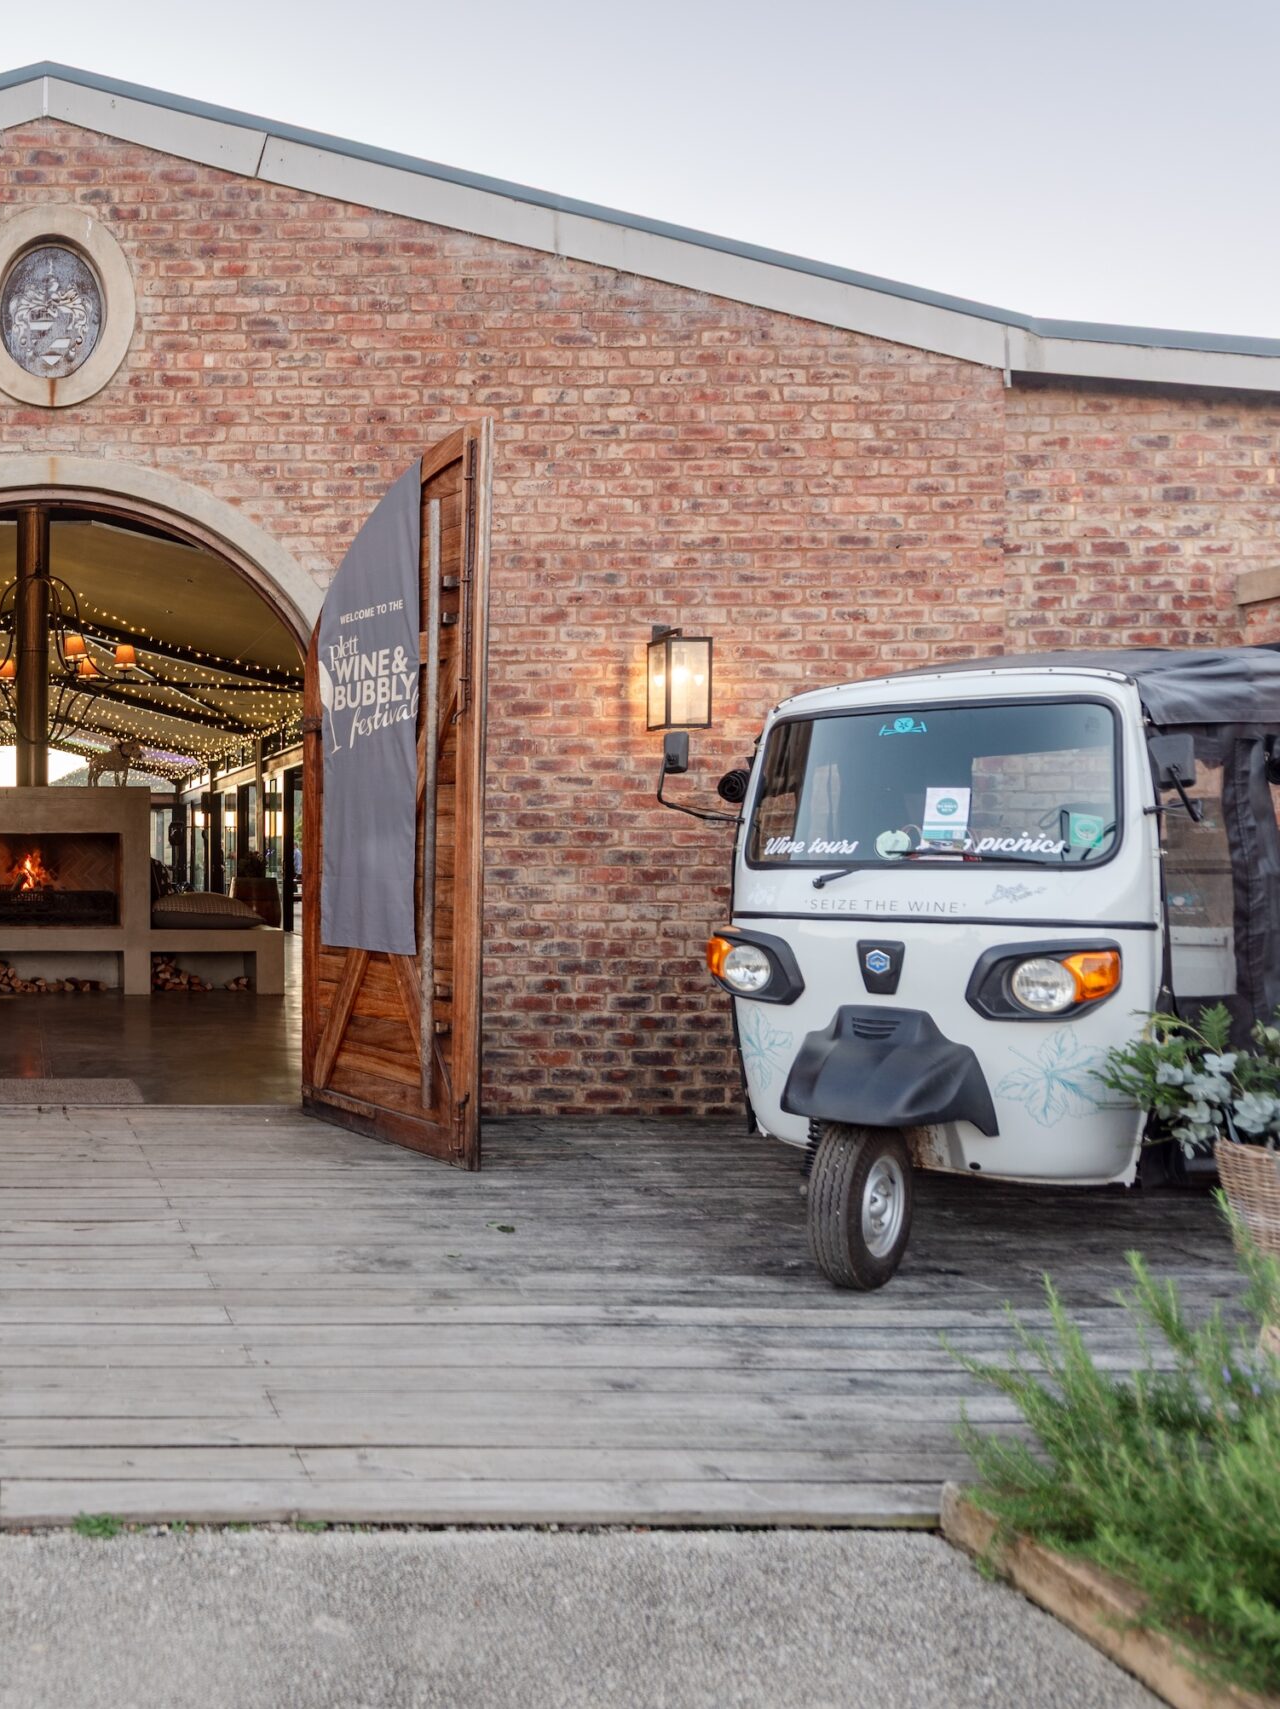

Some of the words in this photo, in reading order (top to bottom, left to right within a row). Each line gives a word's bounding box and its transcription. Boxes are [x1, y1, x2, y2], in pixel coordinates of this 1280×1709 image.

[340, 607, 375, 625] WELCOME
[376, 603, 387, 615] TO
[388, 599, 404, 611] THE
[329, 635, 359, 672] plett
[335, 648, 390, 685] WINE
[391, 645, 409, 673] &
[334, 671, 417, 712] BUBBLY
[349, 685, 420, 749] festival
[764, 836, 805, 857] Wine
[807, 836, 859, 856] tours
[975, 831, 1067, 856] picnics
[864, 899, 899, 912] THE
